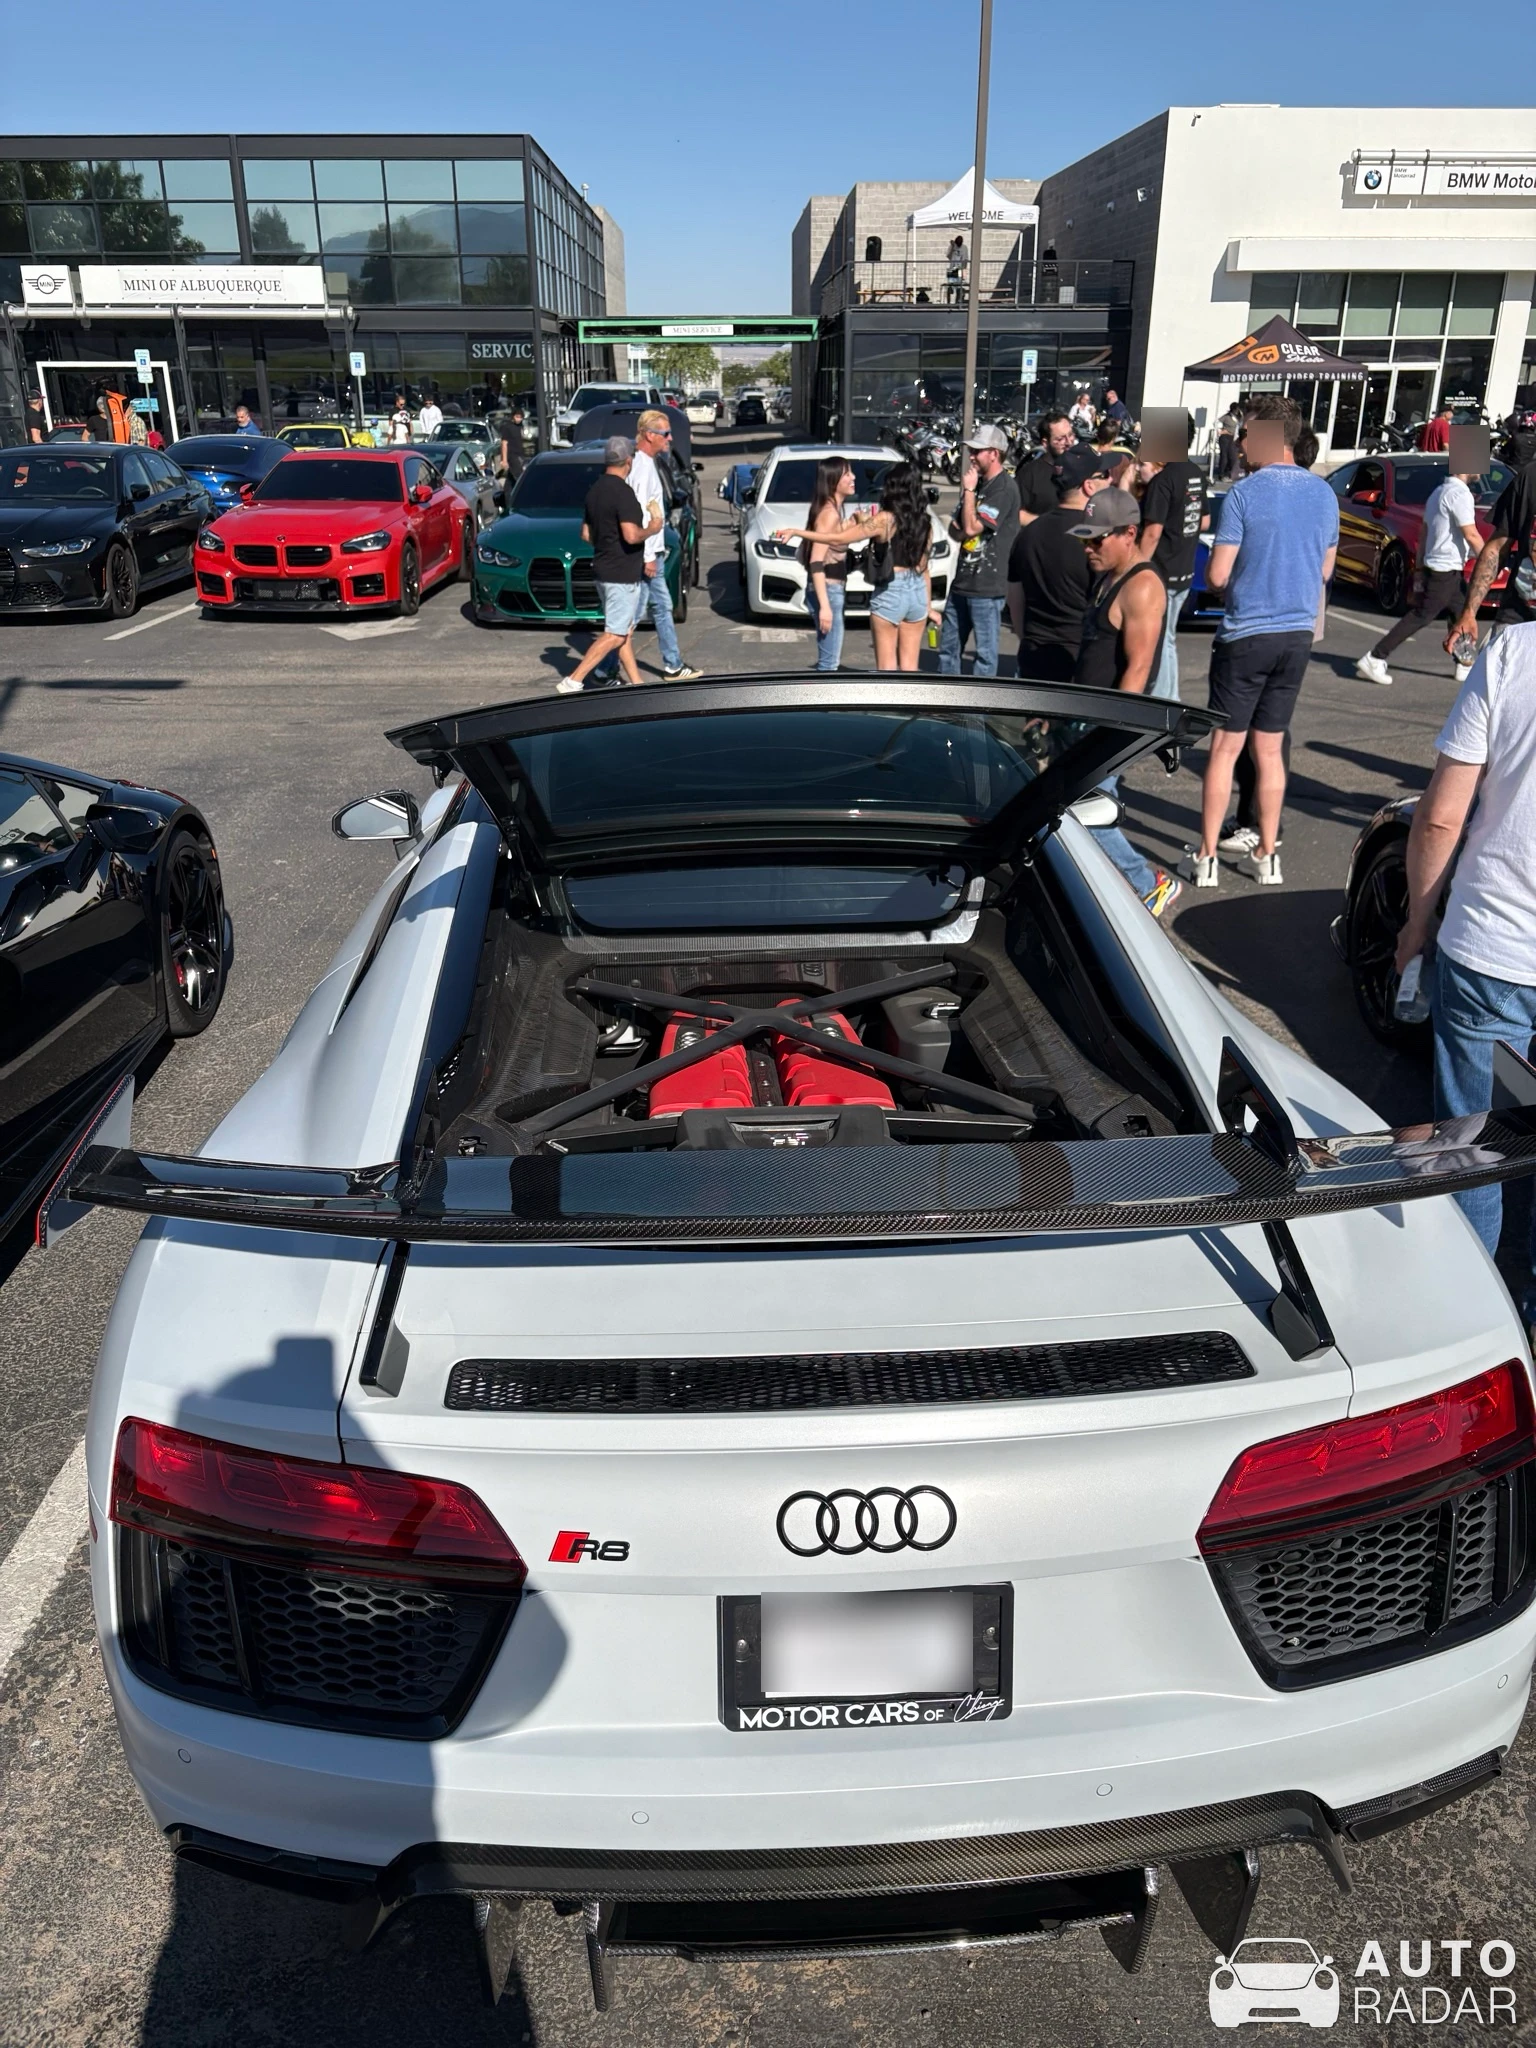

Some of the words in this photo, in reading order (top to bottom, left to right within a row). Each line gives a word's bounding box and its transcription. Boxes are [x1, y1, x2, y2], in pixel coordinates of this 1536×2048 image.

[1447, 173, 1490, 188] BMW
[1493, 173, 1536, 189] Moto
[948, 211, 1005, 221] WELOME
[124, 279, 157, 291] MINI
[159, 279, 177, 291] OF
[180, 279, 282, 294] ALBUQUERQUE
[472, 343, 535, 359] SERVIC
[1281, 343, 1321, 356] CLEAR
[1319, 372, 1364, 381] TRAINING
[566, 1537, 631, 1562] R8
[739, 1705, 839, 1729] MOTOR
[844, 1702, 920, 1725] CARS
[923, 1709, 945, 1722] OF
